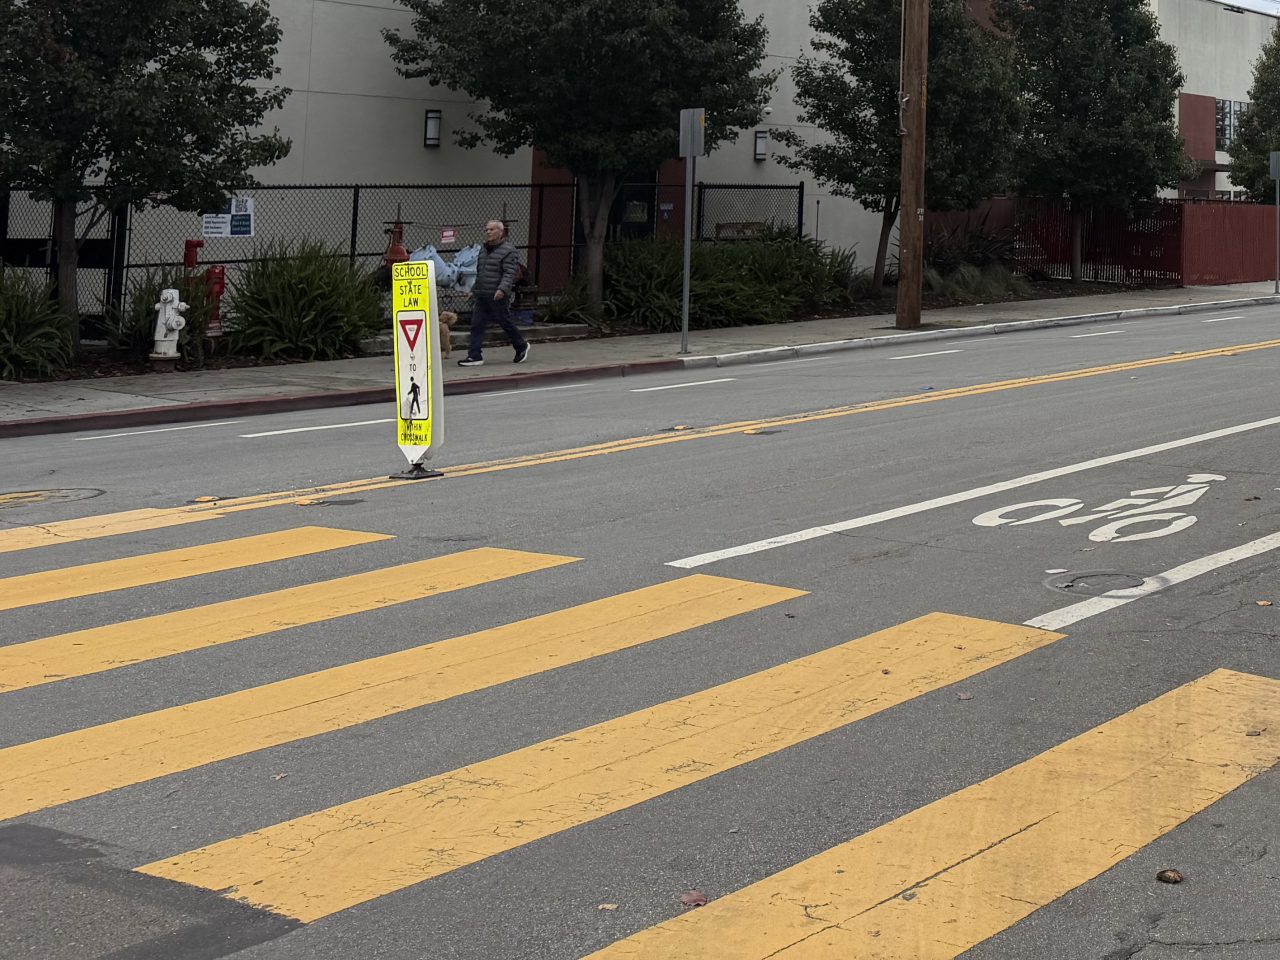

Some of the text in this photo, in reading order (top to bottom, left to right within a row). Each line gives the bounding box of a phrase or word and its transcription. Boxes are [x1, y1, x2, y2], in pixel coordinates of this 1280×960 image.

[394, 265, 427, 278] SCHOOL
[400, 284, 422, 295] STATE
[403, 297, 419, 308] LAW
[409, 363, 417, 372] TO
